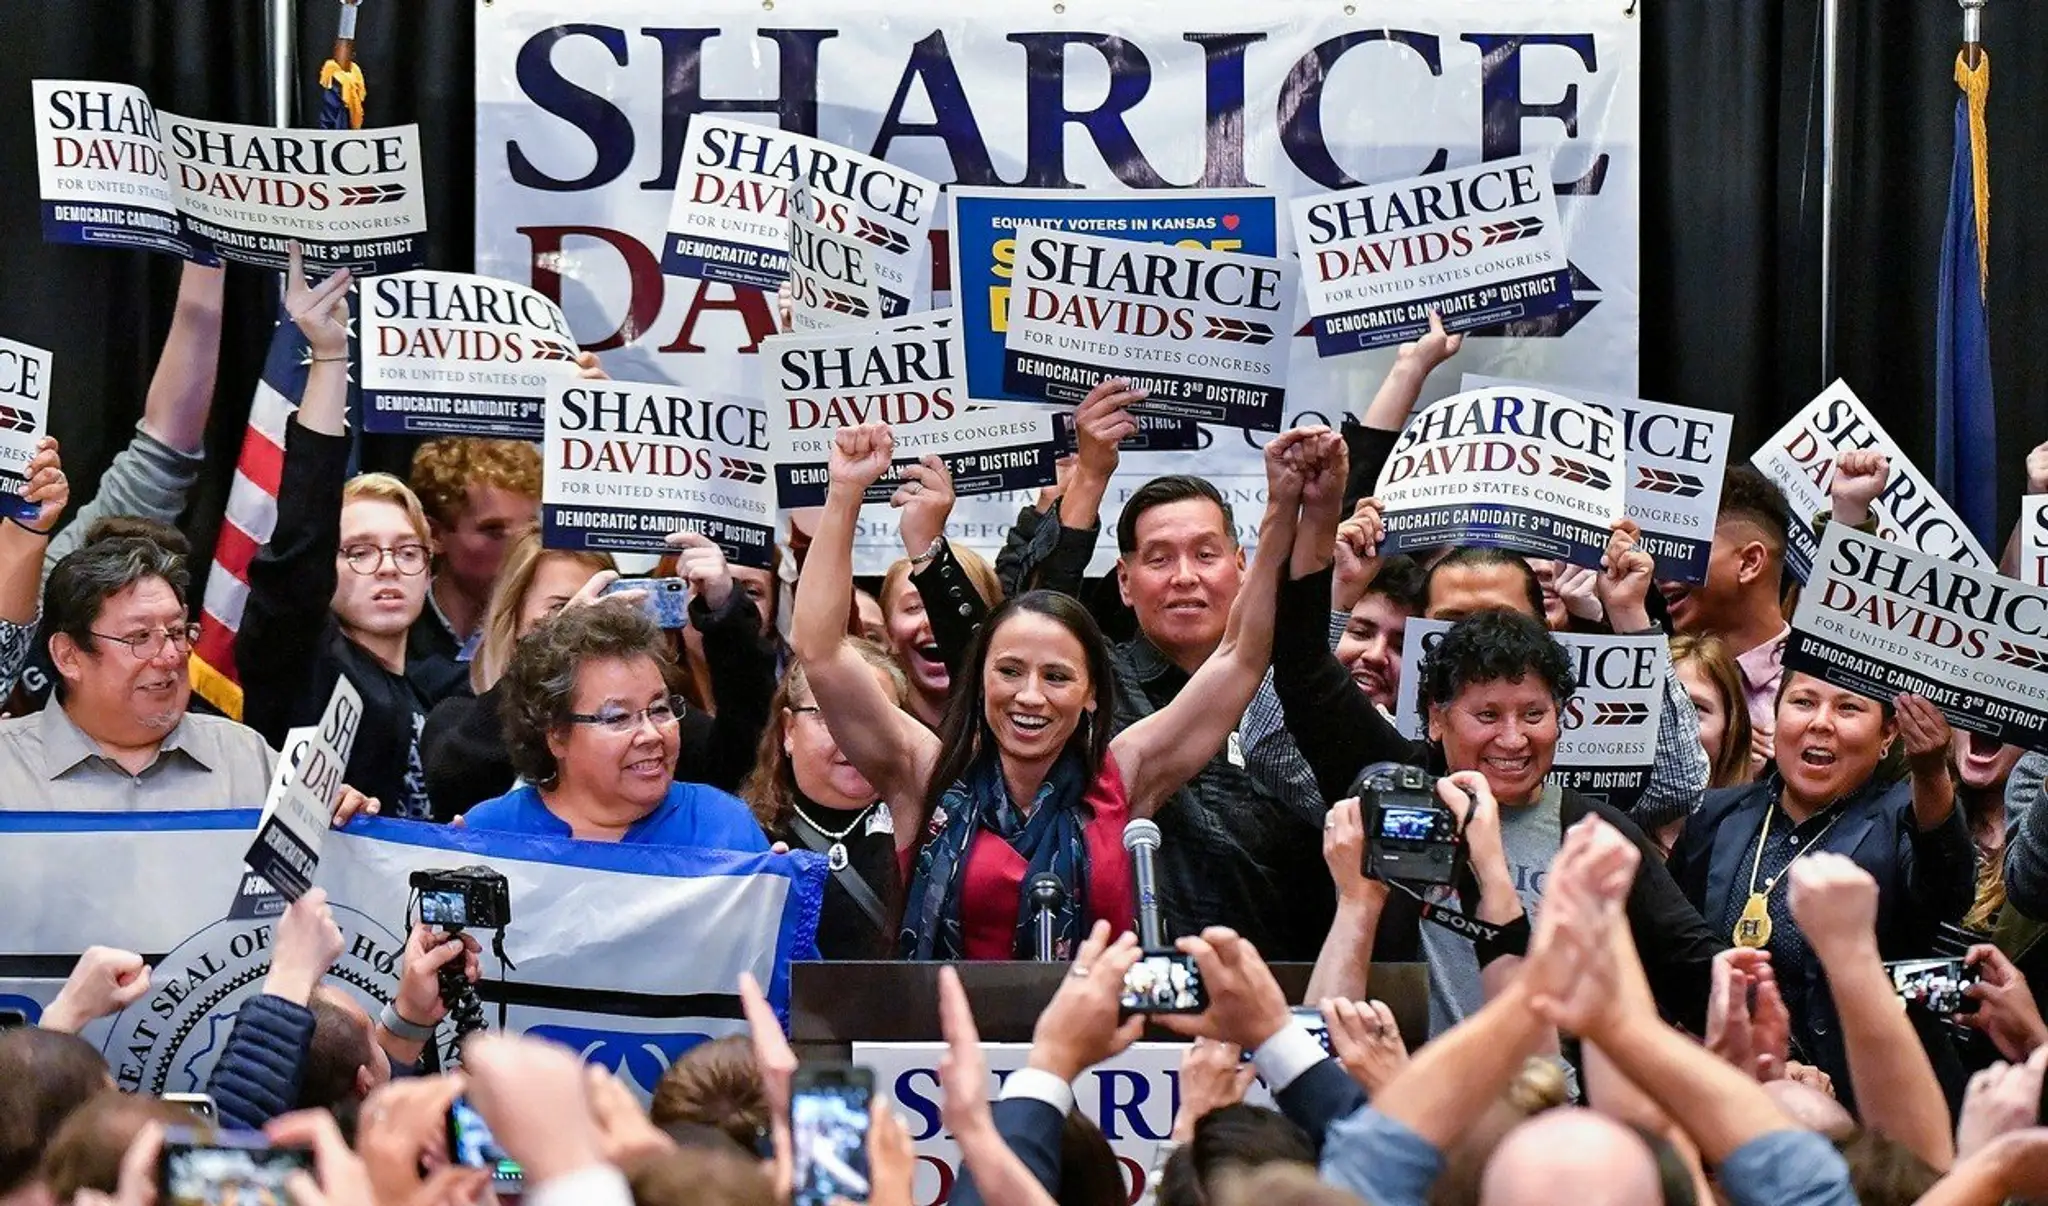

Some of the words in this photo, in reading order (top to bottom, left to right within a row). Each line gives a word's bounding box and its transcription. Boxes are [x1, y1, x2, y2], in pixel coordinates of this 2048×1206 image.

[49, 90, 162, 144] SHARI
[505, 23, 1611, 196] SHARICE
[53, 136, 168, 181] DAVIDS
[171, 124, 407, 177] SHARICE
[57, 178, 84, 190] FOR
[87, 180, 135, 195] UNITED
[176, 162, 330, 211] DAVIDS
[696, 127, 925, 226] SHARICE
[55, 205, 125, 225] DEMOCRATIC
[185, 198, 210, 214] FOR
[213, 206, 268, 223] UNITED
[272, 215, 325, 231] STATES
[329, 214, 411, 232] CONGRESS
[687, 213, 717, 227] FOR
[721, 218, 779, 238] UNITED
[1068, 218, 1127, 231] VOTERS
[1131, 218, 1148, 231] IN
[1152, 217, 1217, 230] KANSAS
[1306, 163, 1541, 245] SHARICE
[186, 219, 257, 250] DEMOCRATIC
[353, 238, 413, 259] DISTRICT
[676, 239, 757, 266] DEMOCRATIC
[791, 220, 867, 288] RICE
[1316, 225, 1473, 283] DAVIDS
[1026, 238, 1282, 312] SHARICE
[1324, 290, 1353, 303] FOR
[1357, 278, 1415, 298] UNITED
[1418, 268, 1471, 288] STATES
[1474, 251, 1552, 275] CONGRESS
[374, 278, 573, 341] SHARICE
[1023, 287, 1195, 340] DAVIDS
[1326, 304, 1405, 336] DEMOCRATIC
[1479, 287, 1498, 306] 3RD
[1500, 276, 1556, 302] DISTRICT
[377, 326, 523, 363] DAVIDS
[781, 338, 954, 392] SHARI
[1023, 329, 1054, 346] FOR
[1059, 335, 1119, 357] UNITED
[1124, 346, 1182, 364] STATES
[1187, 353, 1272, 375] CONGRESS
[380, 367, 407, 380] FOR
[411, 368, 465, 382] UNITED
[469, 372, 518, 386] STATES
[1017, 357, 1101, 387] DEMOCRATIC
[1182, 381, 1204, 398] 3RD
[1206, 385, 1269, 409] DISTRICT
[376, 395, 452, 413] DEMOCRATIC
[453, 400, 519, 418] CANDIDATE
[559, 388, 771, 451] SHARICE
[787, 387, 955, 431] DAVIDS
[792, 439, 822, 452] FOR
[894, 430, 949, 448] STATES
[954, 420, 1038, 441] CONGRESS
[1396, 396, 1616, 463] SHARICE
[560, 438, 712, 481] DAVIDS
[957, 456, 976, 474] 3RD
[980, 448, 1040, 473] DISTRICT
[1384, 441, 1541, 487] DAVIDS
[1769, 457, 1791, 481] FOR
[562, 481, 591, 494] FOR
[596, 483, 653, 498] UNITED
[658, 487, 706, 502] STATES
[710, 492, 767, 514] CONGRESS
[1411, 483, 1468, 498] UNITED
[1473, 481, 1530, 497] STATES
[1534, 489, 1611, 519] CONGRESS
[556, 510, 637, 530] DEMOCRATIC
[639, 514, 707, 536] CANDIDATE
[724, 525, 767, 547] DISTRICT
[1382, 511, 1449, 533] EMOCRATIC
[1453, 509, 1526, 529] CANDIDATE
[1552, 522, 1609, 550] DISTRICT
[1830, 538, 2048, 640] SHARIC
[1818, 577, 1989, 659] DAVIDS
[1814, 615, 1845, 635] FOR
[1850, 625, 1909, 657] UNITED
[1912, 650, 1969, 678] STATES
[1973, 671, 2047, 700] CONGRES
[1801, 637, 1884, 680] DEMOCRATIC
[1887, 669, 1958, 707] CANDIDATE
[1985, 703, 2047, 732] DISTRICT
[1578, 742, 1645, 755] CONGRESS
[1593, 771, 1643, 789] DISTRICT
[1435, 909, 1499, 942] SONY
[152, 953, 226, 1020] SEAL
[229, 925, 272, 957] OF
